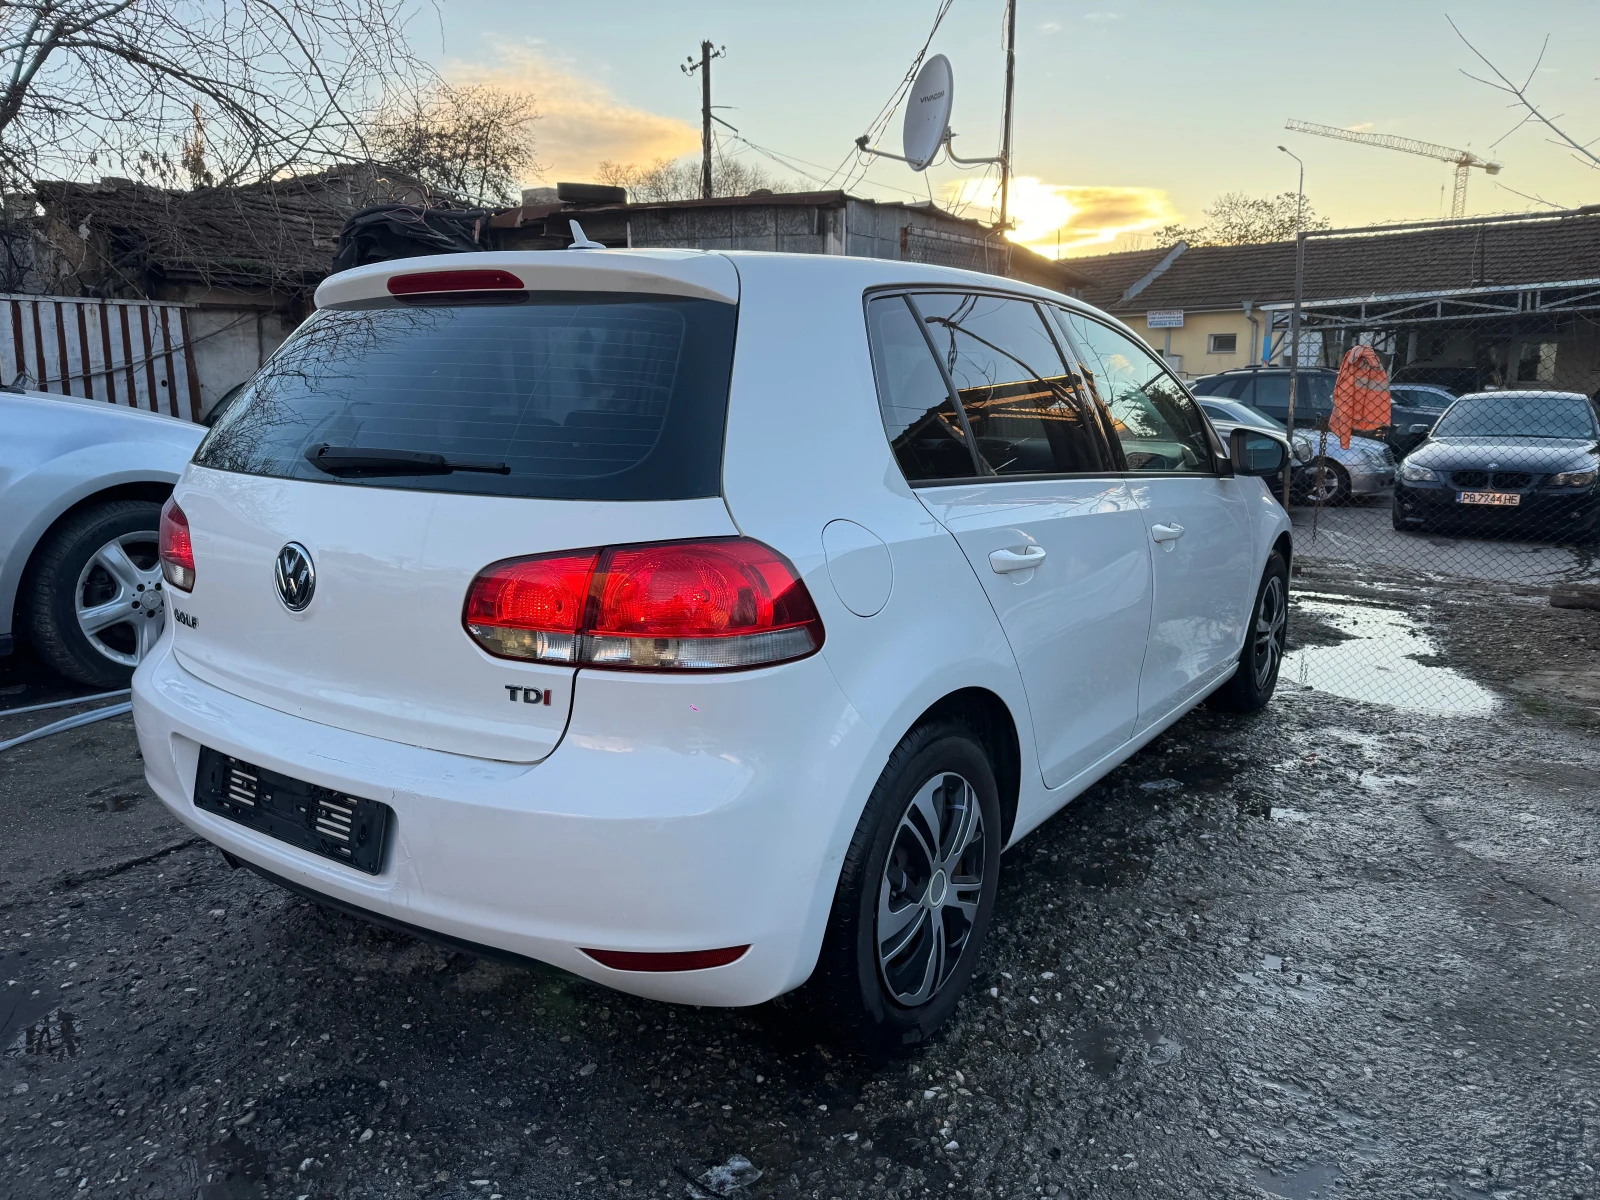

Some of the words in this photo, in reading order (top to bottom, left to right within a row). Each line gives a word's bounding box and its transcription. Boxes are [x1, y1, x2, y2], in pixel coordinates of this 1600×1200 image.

[920, 90, 945, 103] VIVACOM
[275, 545, 314, 607] VW
[174, 608, 199, 630] GOLF
[504, 684, 552, 707] TDI
